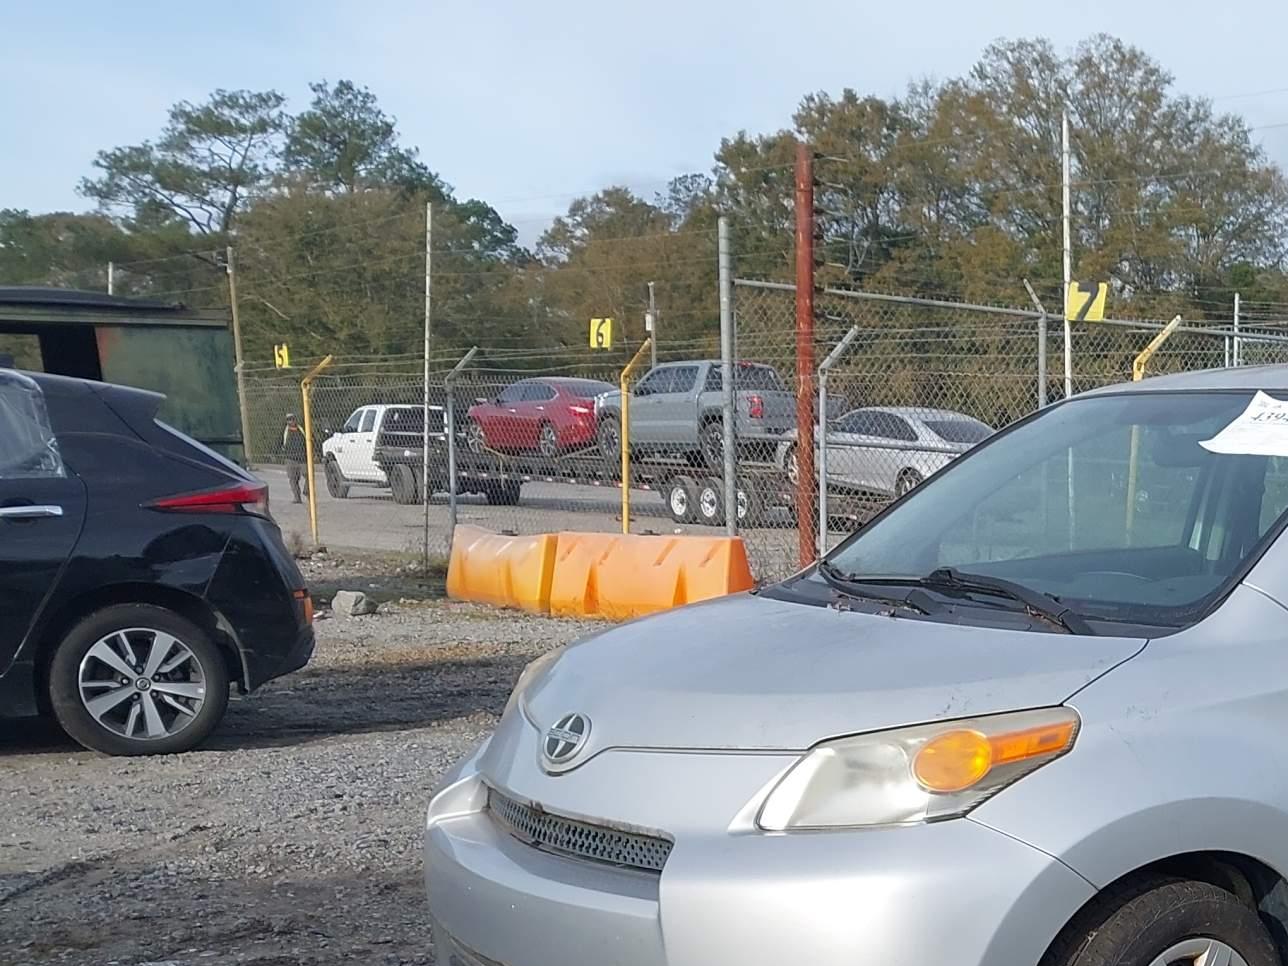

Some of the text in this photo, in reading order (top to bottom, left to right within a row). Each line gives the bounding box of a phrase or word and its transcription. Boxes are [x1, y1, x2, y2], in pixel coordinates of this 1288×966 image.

[1075, 280, 1099, 321] 7
[596, 317, 606, 347] 6
[277, 344, 285, 368] 5
